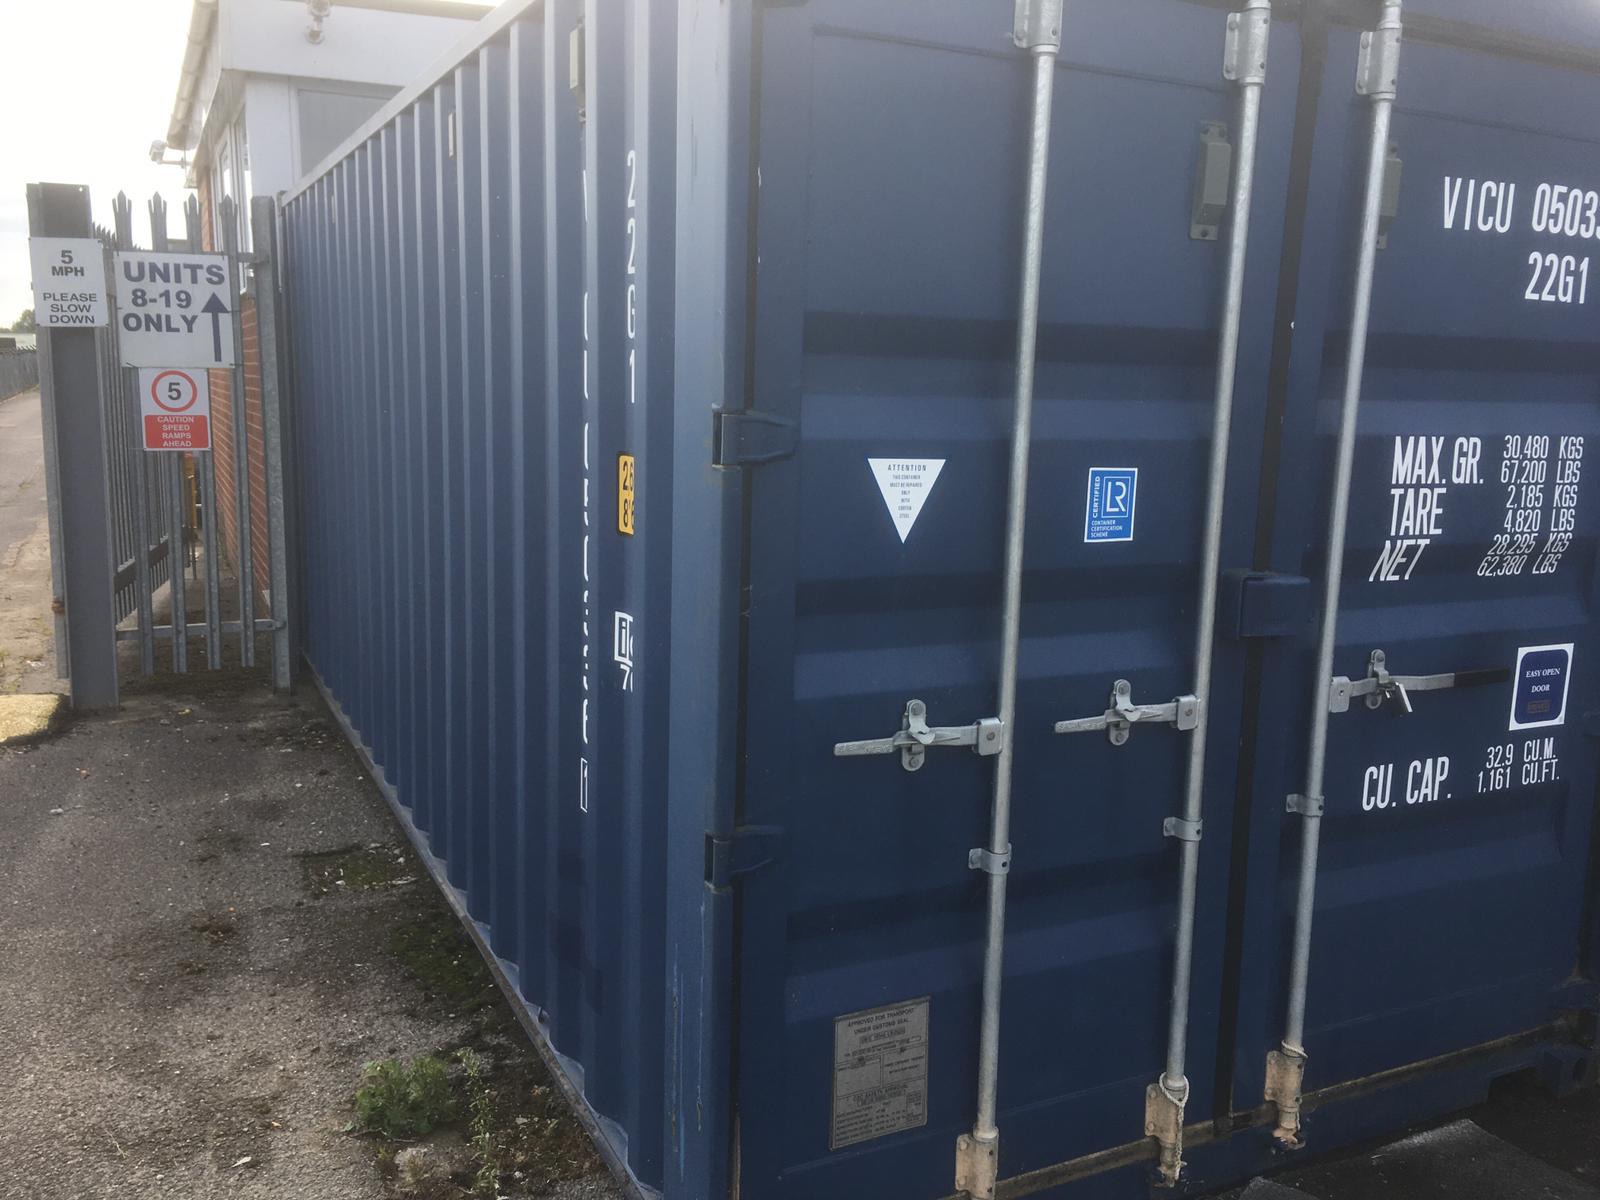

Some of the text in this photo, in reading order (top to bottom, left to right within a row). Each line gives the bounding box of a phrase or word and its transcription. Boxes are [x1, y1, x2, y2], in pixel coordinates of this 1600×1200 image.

[1444, 176, 1600, 240] VICU 0503
[61, 250, 74, 264] 5
[51, 266, 84, 276] MPH
[123, 260, 225, 286] UNITS
[1524, 251, 1589, 304] 22G1
[43, 292, 97, 302] PLEASE
[50, 304, 91, 313] SLOW
[131, 288, 192, 308] 8-19
[50, 314, 95, 324] DOWN
[122, 312, 198, 333] ONLY
[168, 382, 182, 400] 5
[1503, 435, 1584, 460] 30,480 KGS
[1391, 436, 1484, 484] MAX. GR.
[1500, 460, 1581, 484] 67,200 LBS
[1092, 476, 1100, 518] CERTIFIED
[1506, 485, 1578, 509] 2,185 KGS
[1390, 487, 1446, 536] TARE
[1504, 509, 1576, 533] 4,820 LBS
[1487, 533, 1572, 556] 28,295 KGS
[1368, 538, 1430, 582] NET
[1476, 554, 1562, 578] 62,380 LBS
[1542, 668, 1560, 676] OPEN
[1532, 684, 1550, 692] DOOR
[1486, 736, 1556, 768] 32.9 CU.M.
[1362, 756, 1452, 811] CU. CAP.
[1477, 759, 1560, 793] 1,161 CU.FT.
